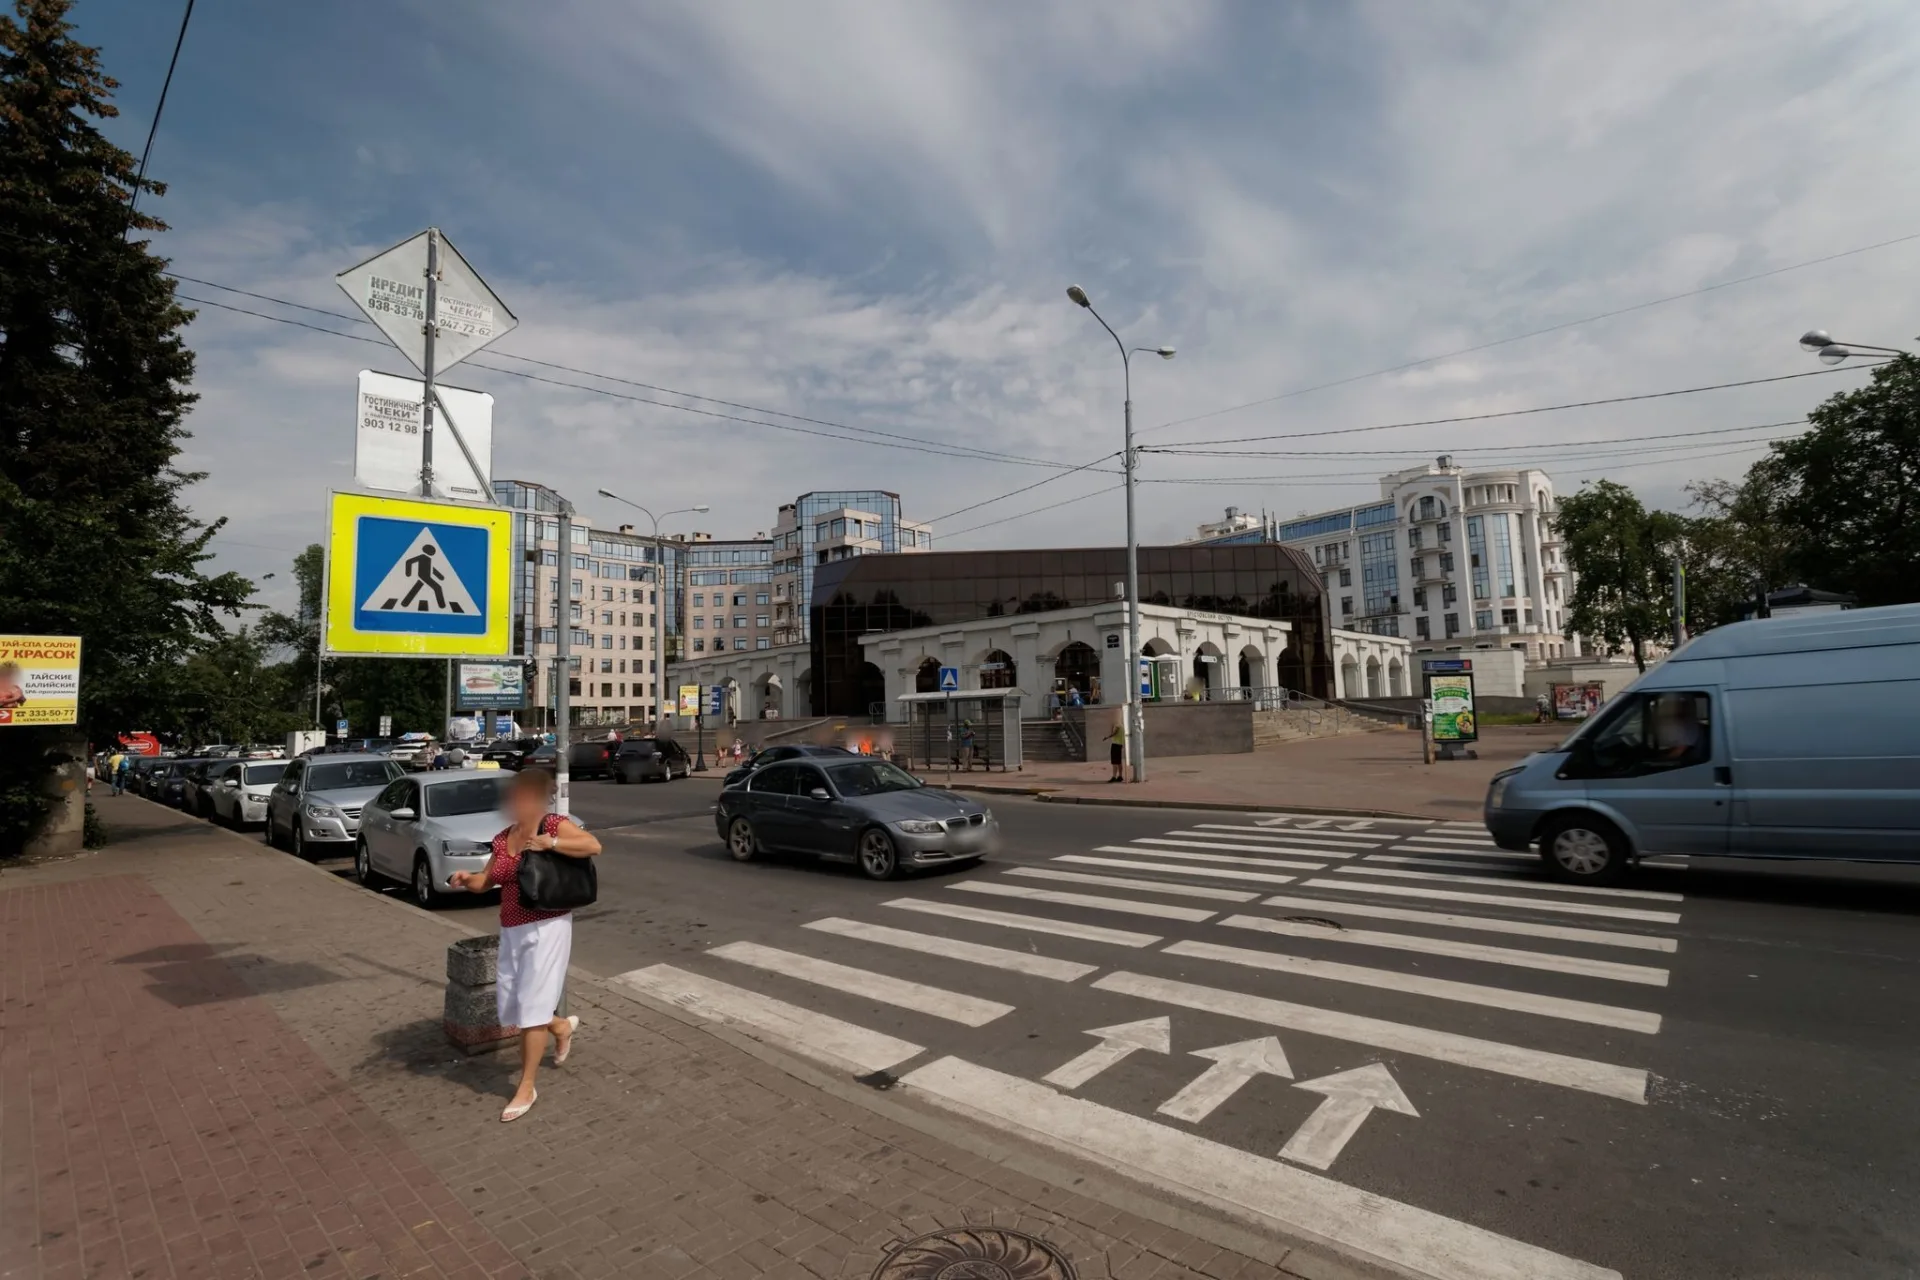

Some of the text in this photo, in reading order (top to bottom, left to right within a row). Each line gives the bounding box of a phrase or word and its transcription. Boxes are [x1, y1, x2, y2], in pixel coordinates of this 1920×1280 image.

[370, 276, 425, 300] КРЕДИТ
[368, 298, 424, 321] 938-33-78
[449, 305, 483, 319] ЧЕКИ
[364, 395, 420, 413] ГОСТИНИЧНЫЕ
[364, 418, 418, 434] 903 12 98
[0, 649, 75, 659] 7 КРАСОК
